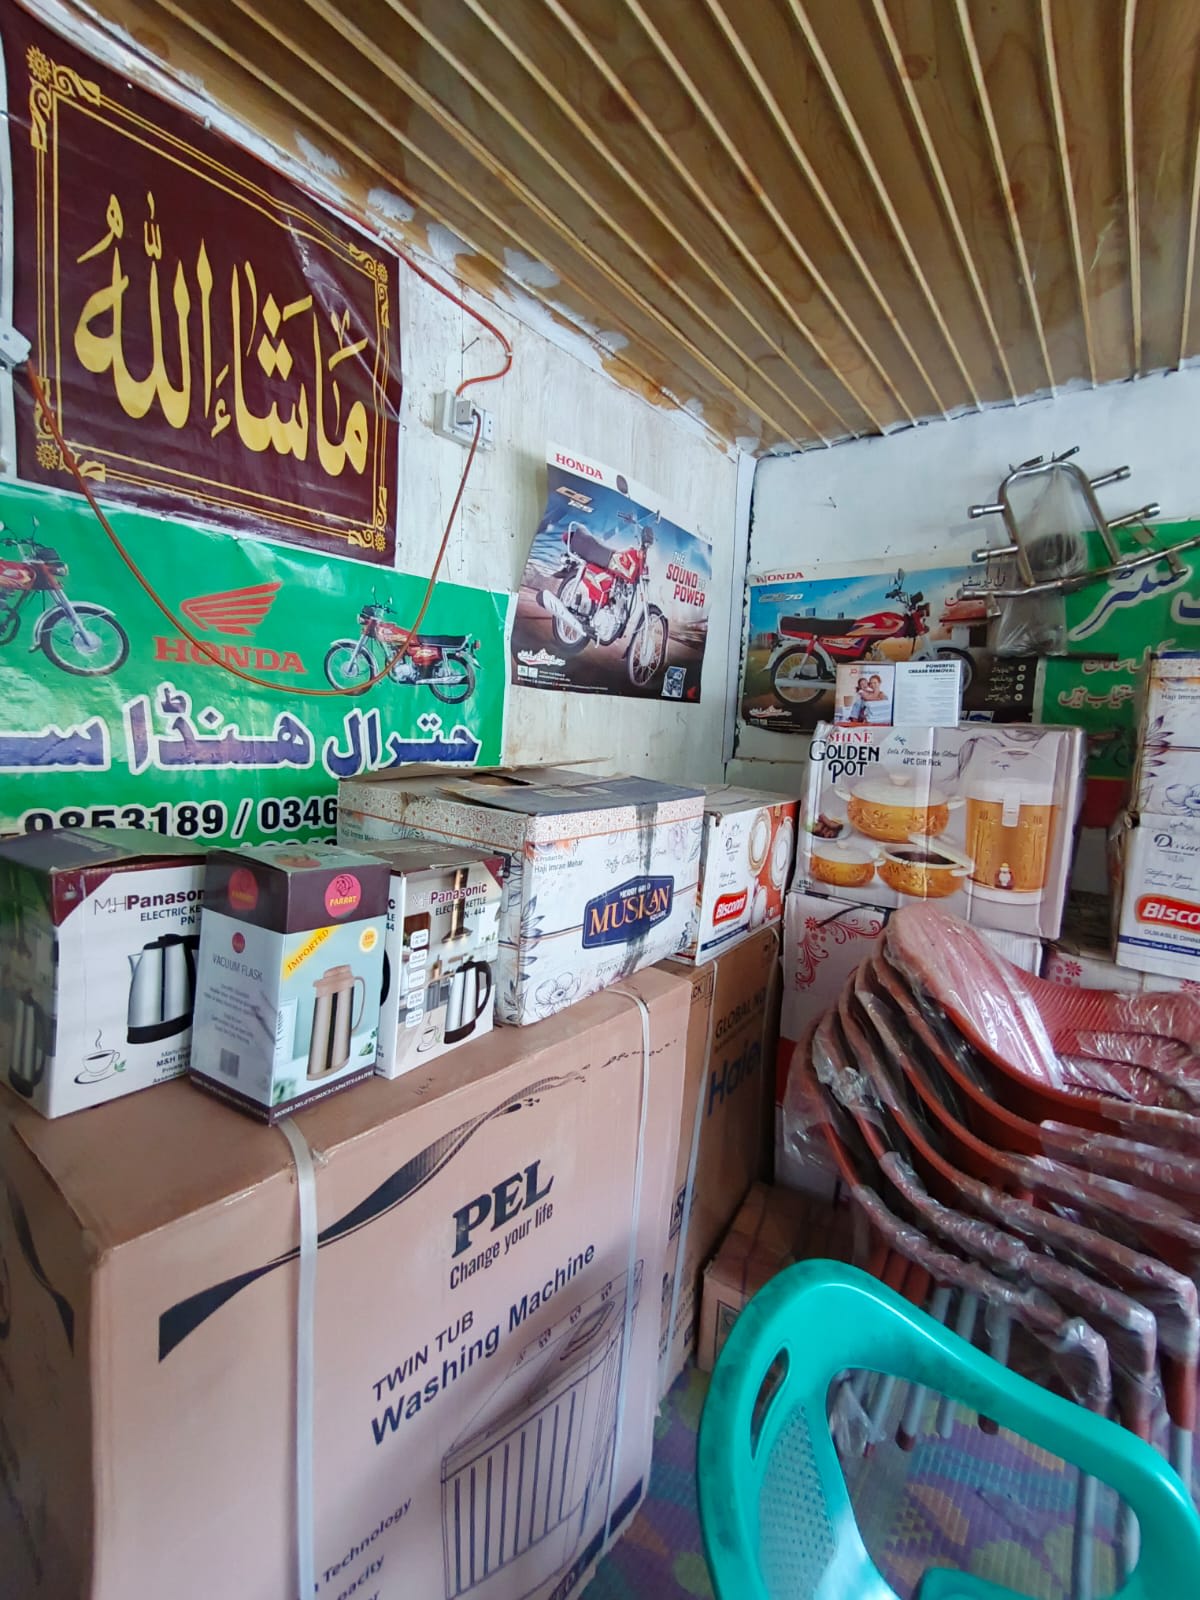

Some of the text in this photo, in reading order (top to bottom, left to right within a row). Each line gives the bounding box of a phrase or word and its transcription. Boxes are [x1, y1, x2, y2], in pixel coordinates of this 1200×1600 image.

[555, 452, 603, 481] HONDA
[666, 563, 698, 588] SOUND
[756, 571, 804, 584] HONDA
[674, 584, 705, 608] POWER
[154, 635, 308, 674] HONDA
[809, 740, 880, 763] GOLDEN
[827, 731, 873, 744] SHINE
[828, 760, 868, 784] POT
[430, 883, 487, 905] Panasonic
[465, 896, 487, 909] KETTLE
[140, 905, 187, 922] ELECTRIC
[180, 915, 195, 926] PN
[589, 885, 671, 937] MUSKAN
[287, 929, 329, 971] IMPORTED
[213, 953, 263, 982] VACUUM FLASK
[708, 1039, 762, 1118] Haie
[452, 1159, 555, 1259] PEL
[449, 1201, 554, 1291] Change your life
[370, 1244, 595, 1447] Washing Machine
[372, 1310, 475, 1402] TWIN TUB
[323, 1497, 412, 1583] Technology
[337, 1554, 385, 1600] pacity
